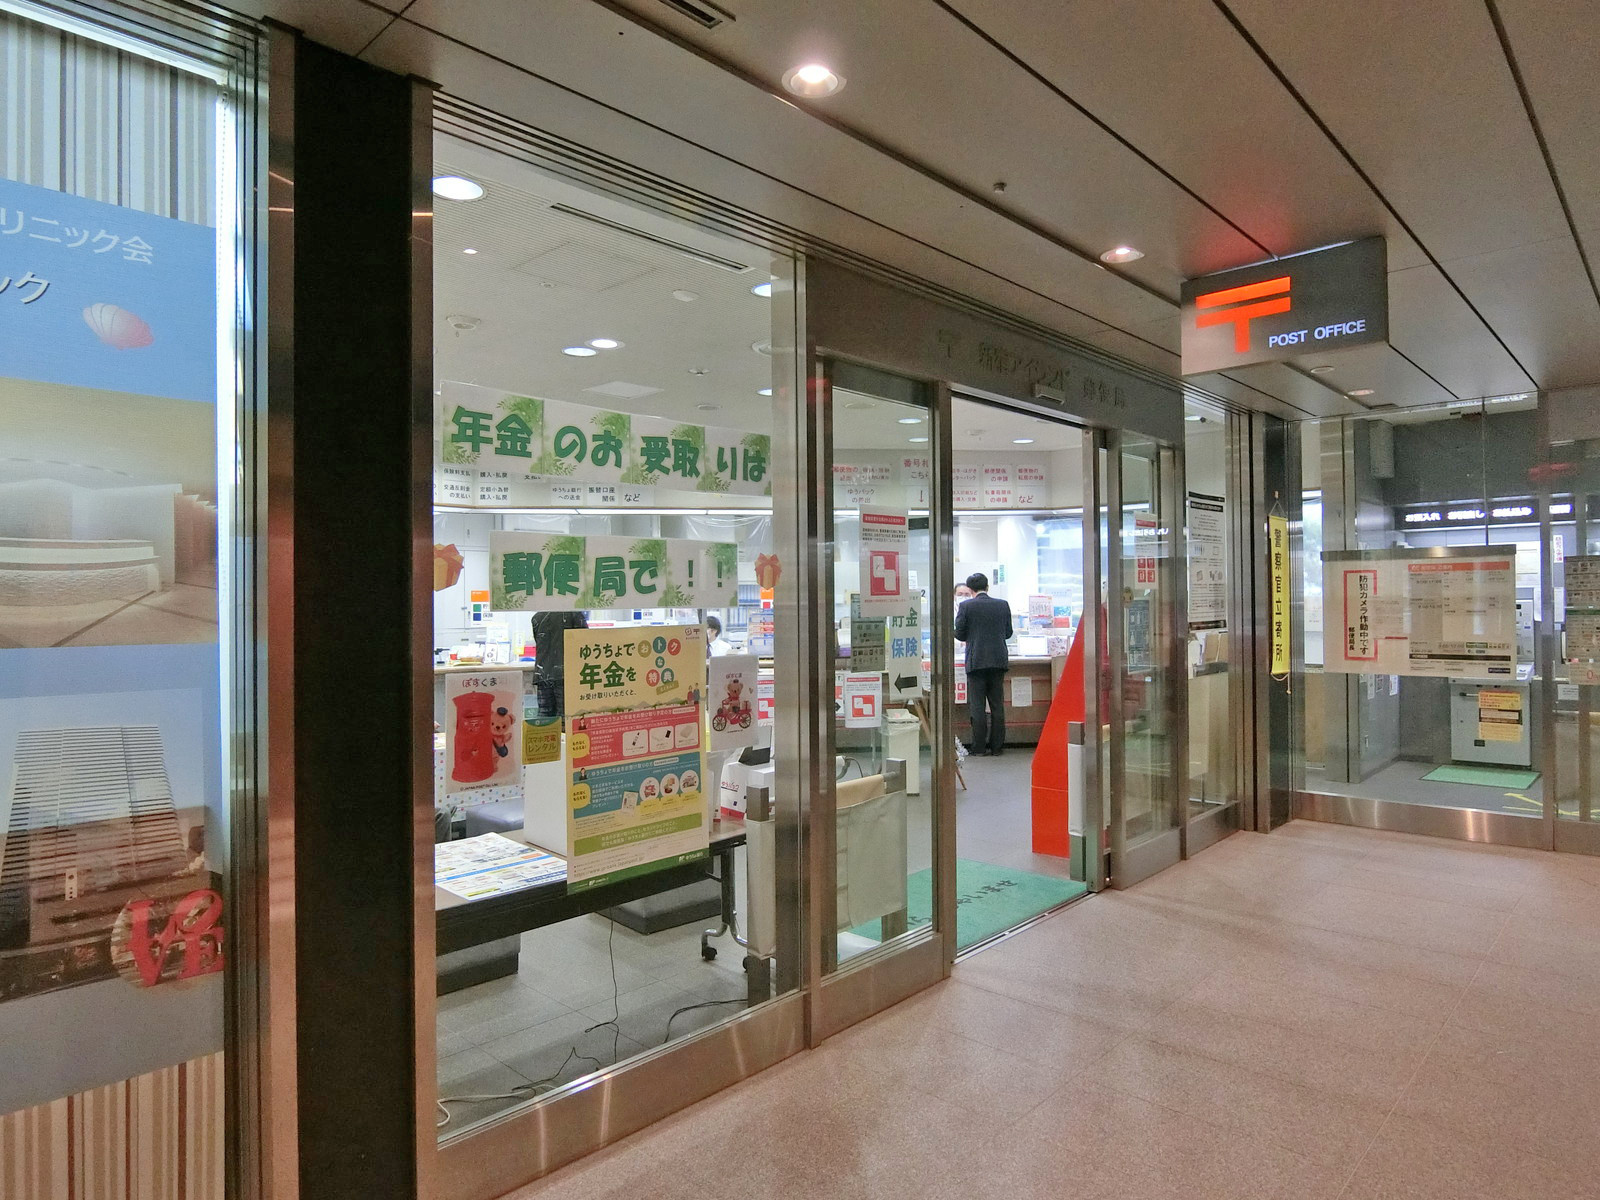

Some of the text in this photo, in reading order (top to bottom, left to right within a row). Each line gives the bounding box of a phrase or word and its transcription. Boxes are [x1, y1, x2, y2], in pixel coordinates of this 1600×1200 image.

[1269, 319, 1366, 348] POST OFFICE
[451, 405, 766, 482] 年金のお受取りは
[624, 493, 641, 503] など
[1018, 495, 1034, 504] など
[1359, 574, 1369, 655] 防犯カメラ作動中です
[891, 637, 918, 659] 保険
[1348, 626, 1356, 651] 郵便局長
[579, 642, 636, 660] ゆうちょで
[579, 660, 637, 690] 年金を
[528, 743, 557, 753] レンタル
